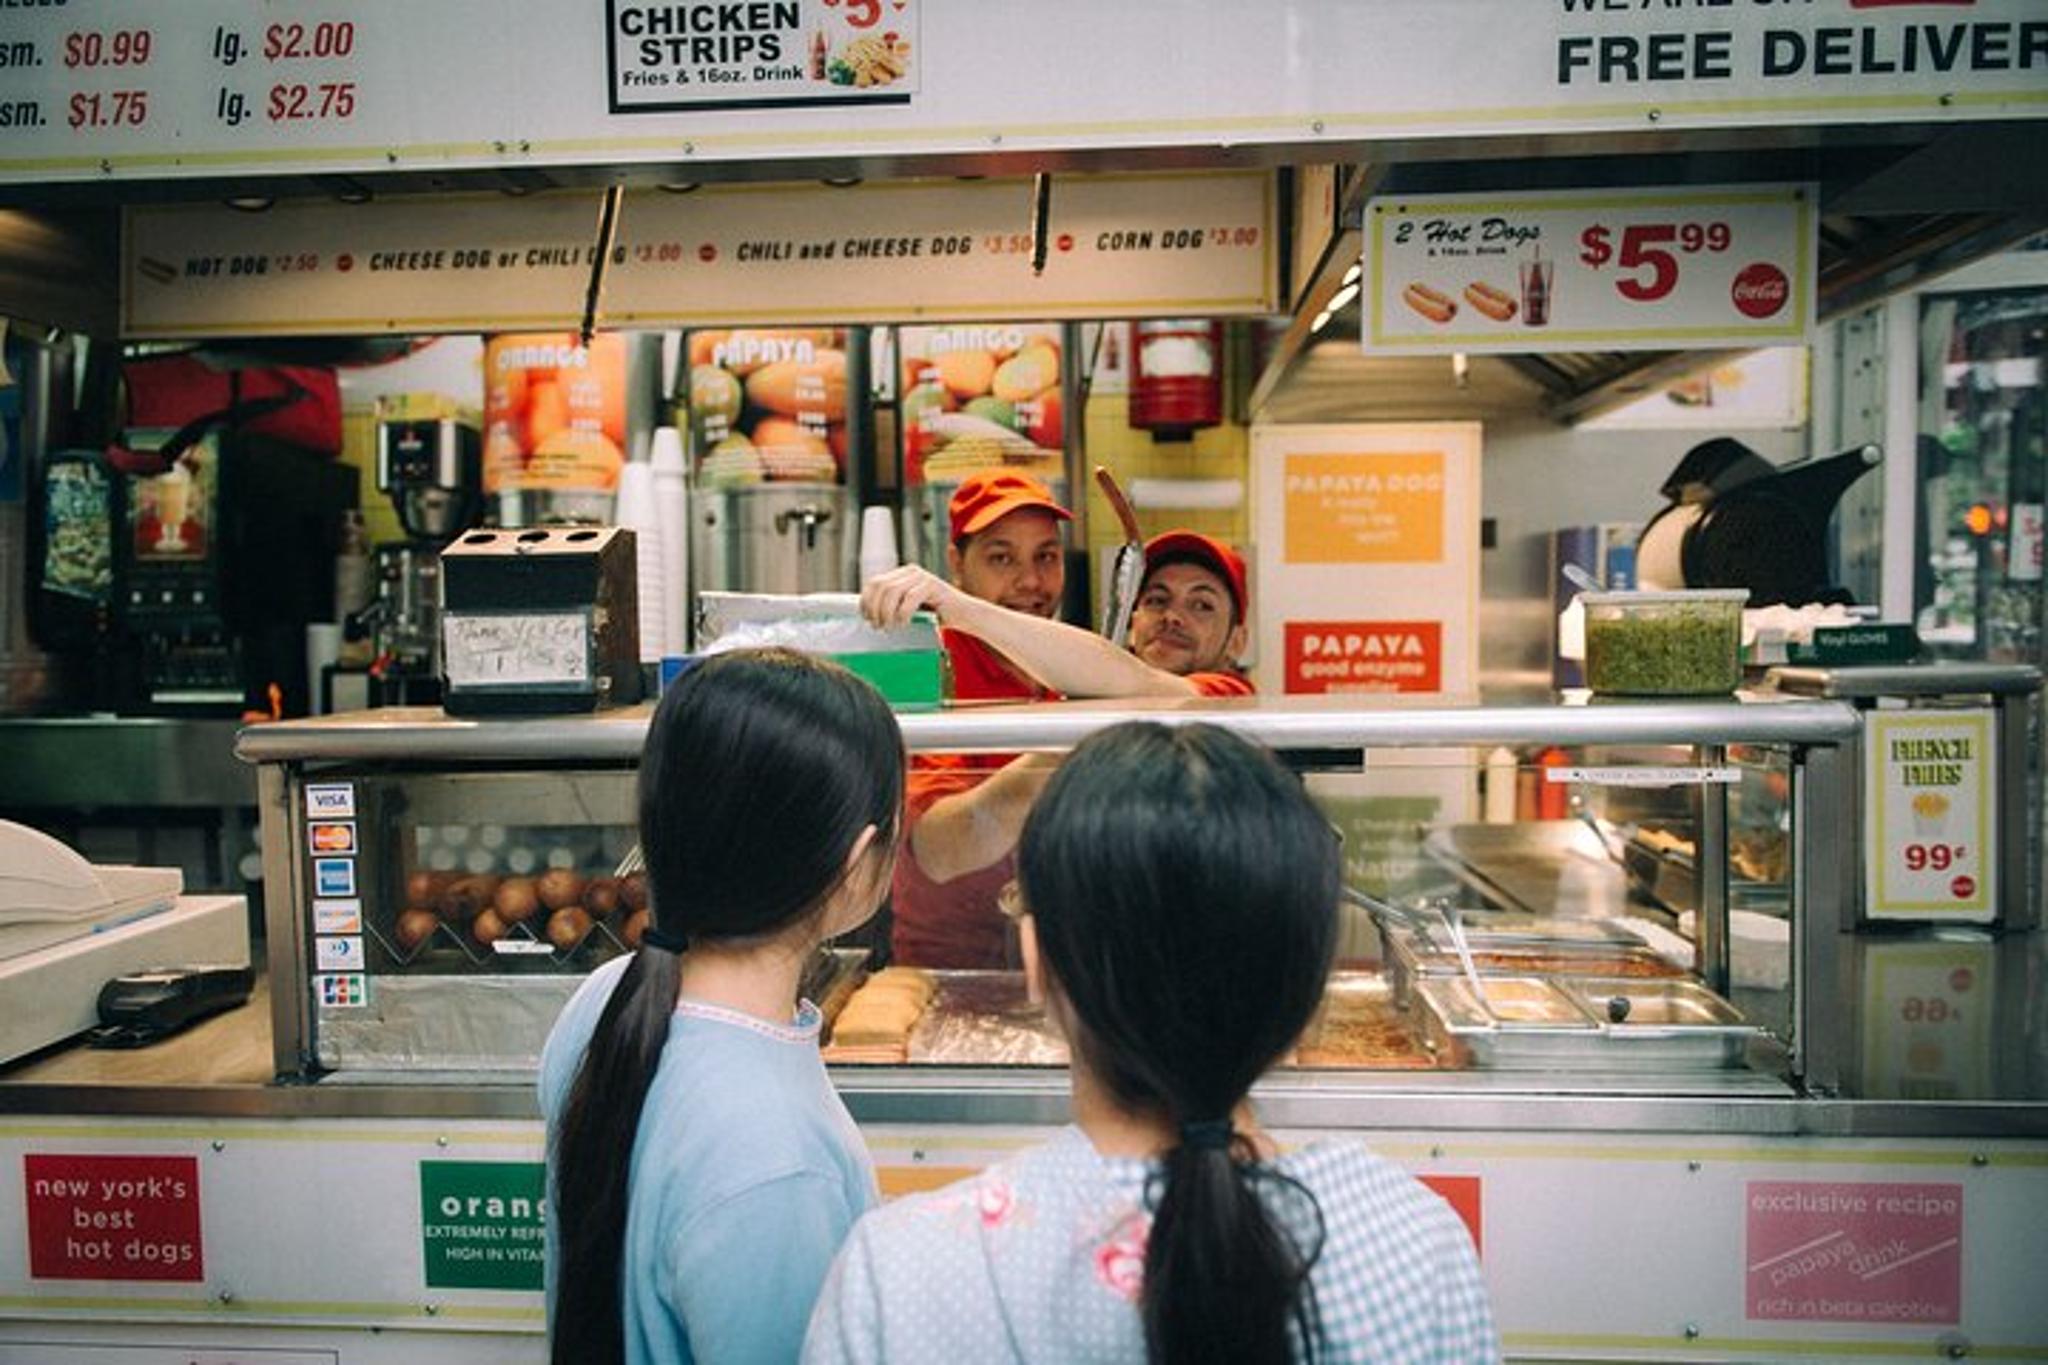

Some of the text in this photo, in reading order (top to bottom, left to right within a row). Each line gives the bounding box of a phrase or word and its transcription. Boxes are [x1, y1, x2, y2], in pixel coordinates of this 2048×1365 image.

[620, 2, 800, 36] CHICKEN
[64, 30, 150, 68] $0.99
[213, 26, 248, 66] lg.
[264, 21, 355, 62] $2.00
[639, 33, 781, 66] STRIPS
[1557, 32, 1732, 84] FREE
[623, 65, 803, 86] Fries & 16oz. Drink
[0, 83, 356, 128] sm. $1.75 lg. $2.75
[1096, 231, 1154, 251] CORN
[1161, 229, 1204, 249] DOG
[1395, 218, 1541, 248] 2 Hot Dogs
[369, 250, 446, 271] CHEESE
[452, 249, 491, 269] DOG
[497, 252, 519, 268] or
[525, 247, 580, 267] CHILI
[736, 240, 792, 262] CHILI
[799, 240, 836, 260] and
[843, 237, 923, 259] CHEESE
[931, 236, 971, 255] DOG
[185, 256, 224, 277] HOT
[230, 255, 268, 275] DOG
[1302, 633, 1424, 657] PAPAYA
[34, 1176, 187, 1201] new york's
[1751, 1191, 1958, 1218] exclusive recipe
[73, 1207, 135, 1229] best
[425, 1224, 507, 1238] EXTREMELY
[66, 1237, 194, 1264] hot dogs
[445, 1247, 483, 1260] HIGH
[486, 1247, 504, 1260] IN
[1771, 1240, 1856, 1289] papaya
